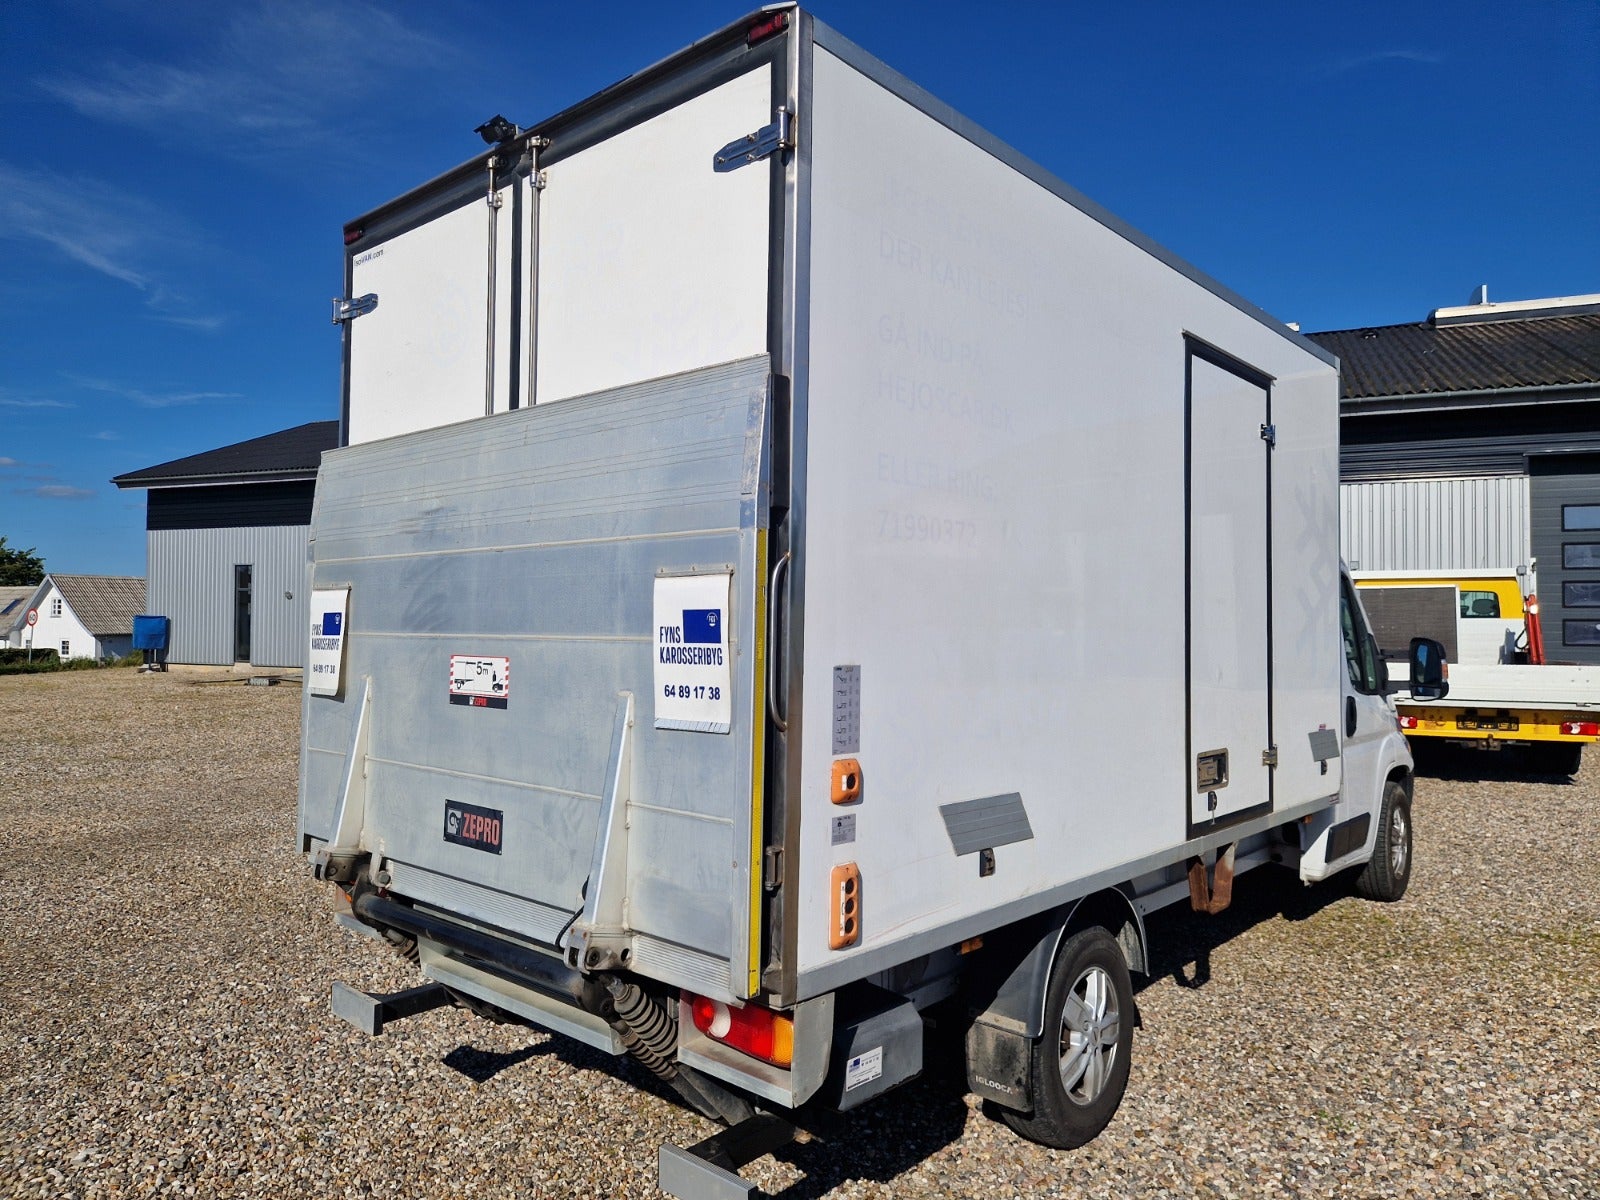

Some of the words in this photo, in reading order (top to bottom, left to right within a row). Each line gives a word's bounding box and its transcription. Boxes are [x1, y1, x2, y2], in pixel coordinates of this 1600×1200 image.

[660, 626, 681, 643] FYNS
[660, 646, 723, 666] KAROSSERIBYG
[476, 661, 483, 676] 5
[664, 684, 676, 698] 64
[678, 685, 690, 699] 89
[693, 685, 705, 700] 17
[708, 686, 720, 701] 38
[462, 812, 500, 846] ZEPRO
